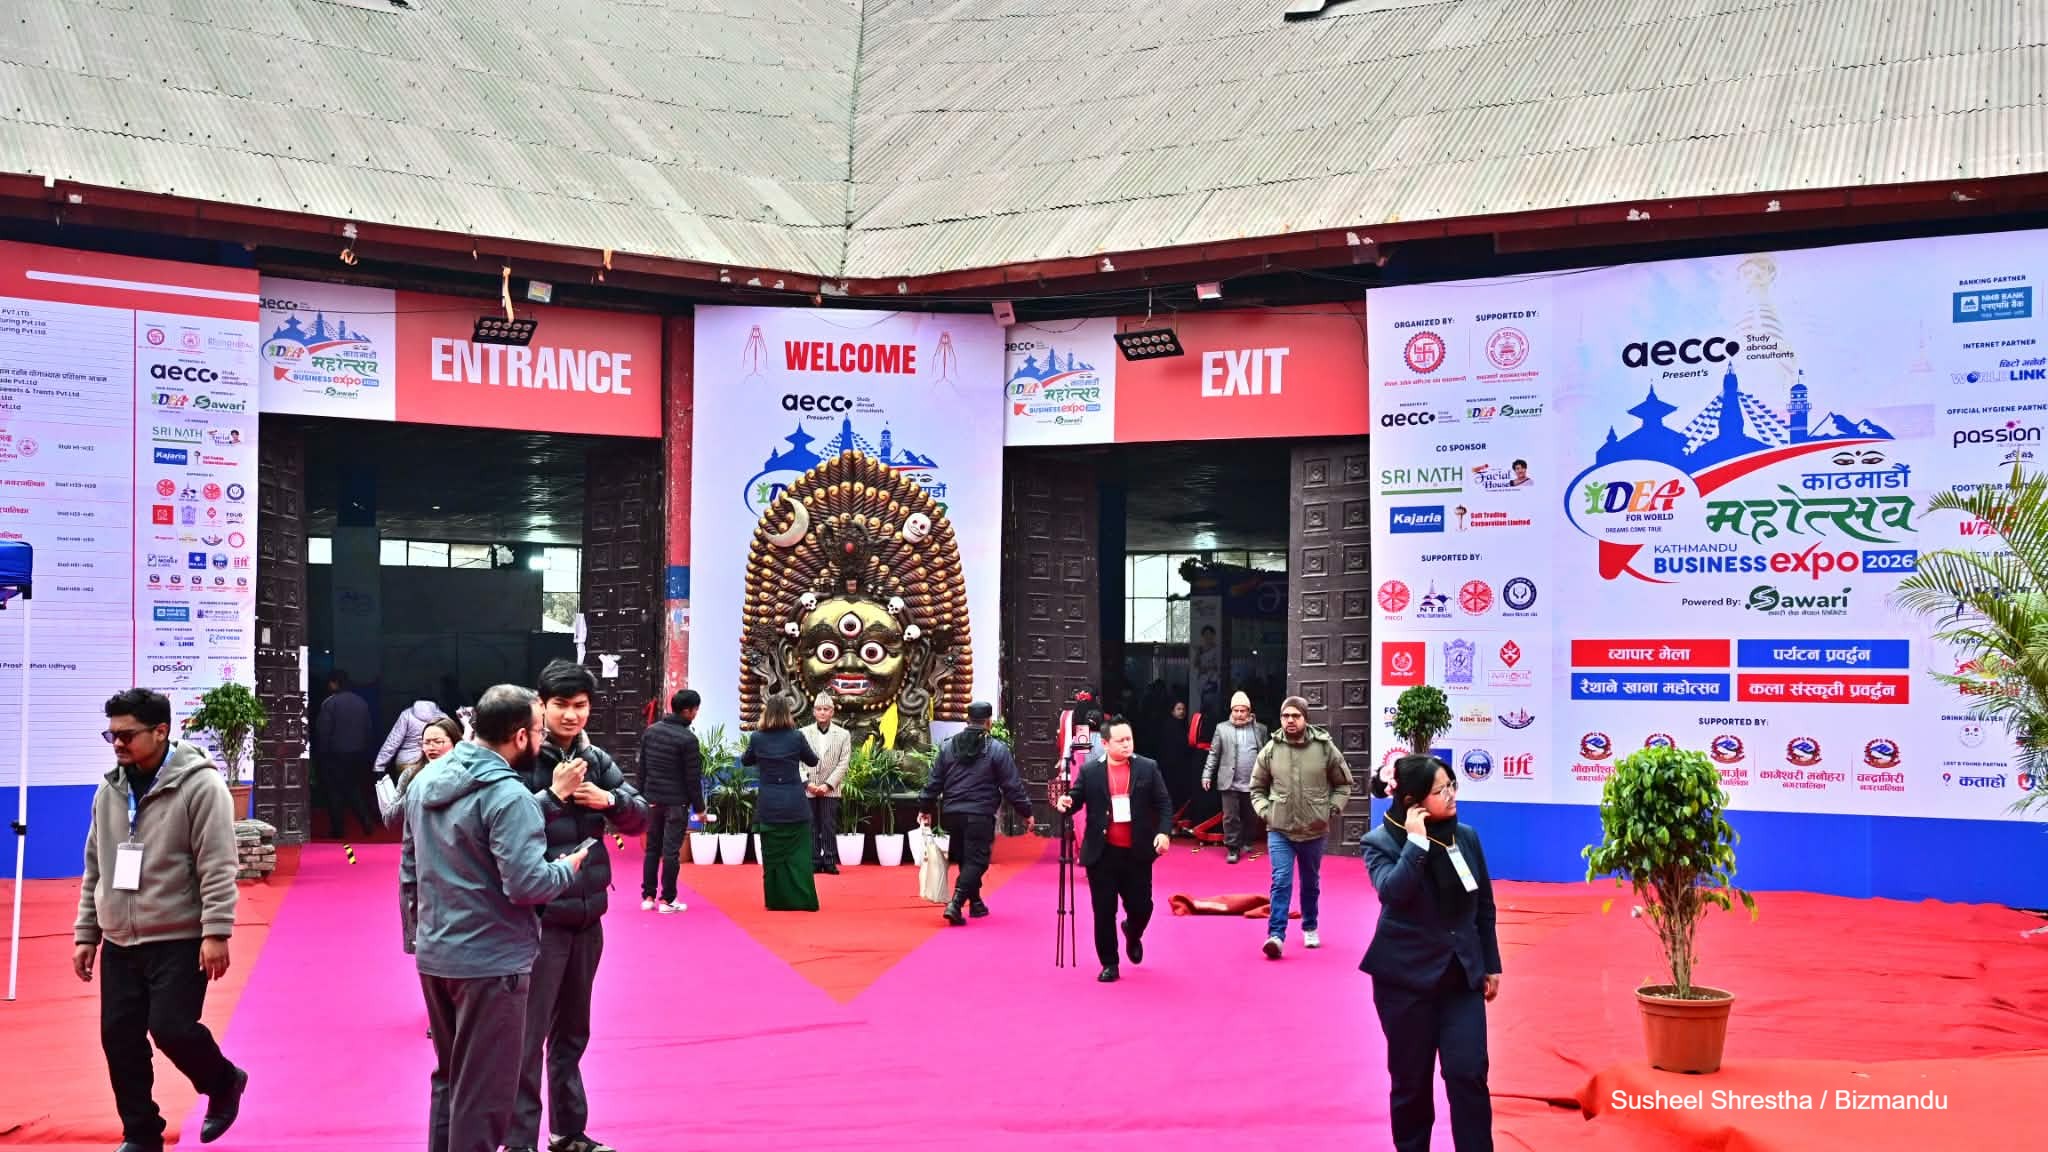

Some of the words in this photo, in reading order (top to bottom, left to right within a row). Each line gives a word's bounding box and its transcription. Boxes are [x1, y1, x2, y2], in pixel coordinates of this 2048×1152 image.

[1959, 278, 1992, 286] BANKING
[1993, 275, 2026, 283] PARTNER
[2001, 292, 2024, 300] BANK
[1475, 311, 1524, 322] SUPPORTED
[1394, 319, 1440, 329] ORGANIZED
[1746, 334, 1771, 343] Study
[1746, 342, 1778, 351] abroad
[1963, 341, 2000, 350] INTERNET
[2001, 339, 2036, 347] PARTNER
[784, 340, 917, 374] WELCOME
[1622, 336, 1727, 368] aecc
[1746, 350, 1795, 361] consultants
[431, 337, 632, 395] ENTRANCE
[1201, 347, 1290, 398] EXIT
[1662, 369, 1709, 380] Present's
[781, 393, 845, 413] aecc
[1947, 407, 1981, 415] OFFICIAL
[1982, 405, 2016, 413] HYGIENE
[1381, 412, 1430, 428] aecc
[152, 426, 171, 436] SRI
[1953, 420, 2041, 448] passion
[1435, 445, 1448, 453] CO
[1449, 443, 1487, 452] SPONSOR
[1381, 469, 1411, 485] SRI
[1417, 466, 1463, 483] NATH
[1393, 512, 1442, 526] Kajaria
[1625, 514, 1642, 522] FOR
[1643, 513, 1674, 521] WORLD
[1705, 483, 1919, 545] महोत्सव
[1605, 526, 1630, 534] DREAMS
[1654, 543, 1738, 554] KATHMANDU
[1421, 554, 1468, 562] SUPPORTED
[1654, 555, 1767, 574] BUSINESS
[1770, 541, 1860, 580] expo
[1866, 555, 1915, 569] 2026
[1681, 597, 1724, 607] Powered
[1725, 597, 1741, 608] By:
[1744, 585, 1852, 611] Sawari
[1608, 646, 1655, 661] व्यापार
[1658, 645, 1692, 661] मेला
[1773, 646, 1820, 661] पर्यटन
[1622, 682, 1658, 694] खाना
[1662, 680, 1720, 695] महोत्सव
[1749, 683, 1784, 696] कला
[1698, 718, 1752, 726] SUPPORTED
